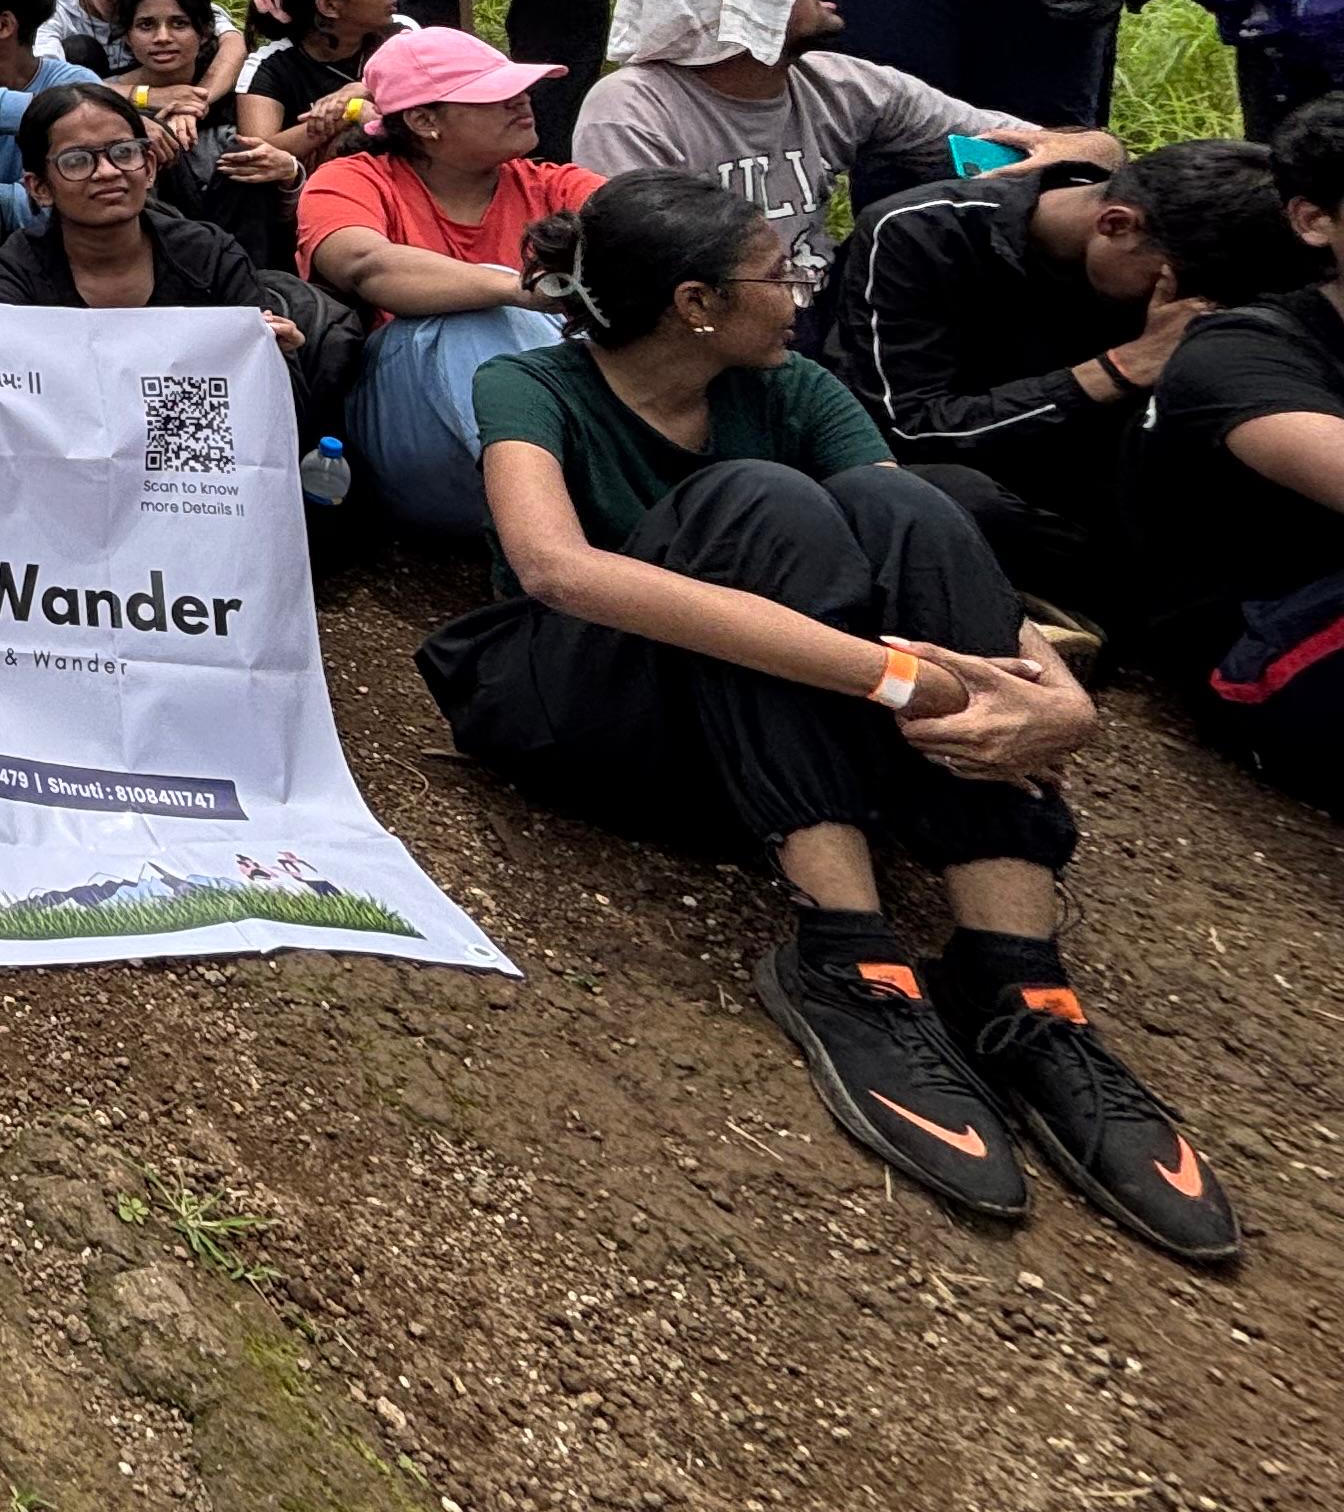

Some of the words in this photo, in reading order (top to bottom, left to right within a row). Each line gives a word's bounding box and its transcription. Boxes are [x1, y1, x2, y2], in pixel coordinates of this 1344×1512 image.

[143, 480, 178, 493] Scan
[182, 481, 197, 494] to
[200, 482, 239, 496] know
[140, 501, 179, 513] more
[182, 500, 232, 516] Details
[4, 647, 18, 667] &
[33, 650, 128, 675] Wander
[115, 785, 216, 809] 8108411747
